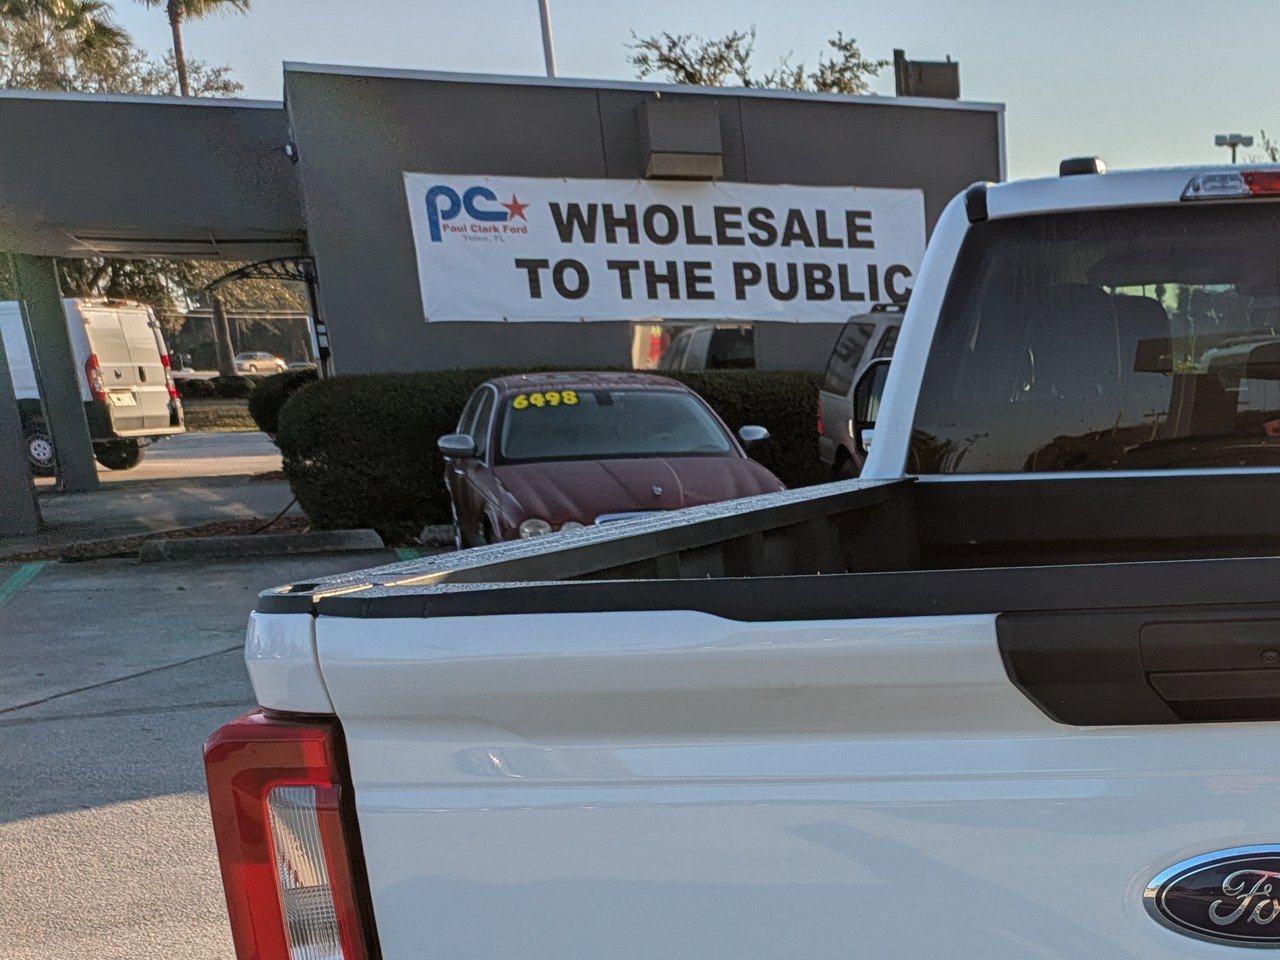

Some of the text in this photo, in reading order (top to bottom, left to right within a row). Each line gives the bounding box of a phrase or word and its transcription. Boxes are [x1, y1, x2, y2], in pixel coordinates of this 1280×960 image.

[442, 223, 528, 234] Paul Clark Ford
[549, 202, 875, 249] WHOLESALE
[514, 258, 913, 304] TO THE PUBLIC
